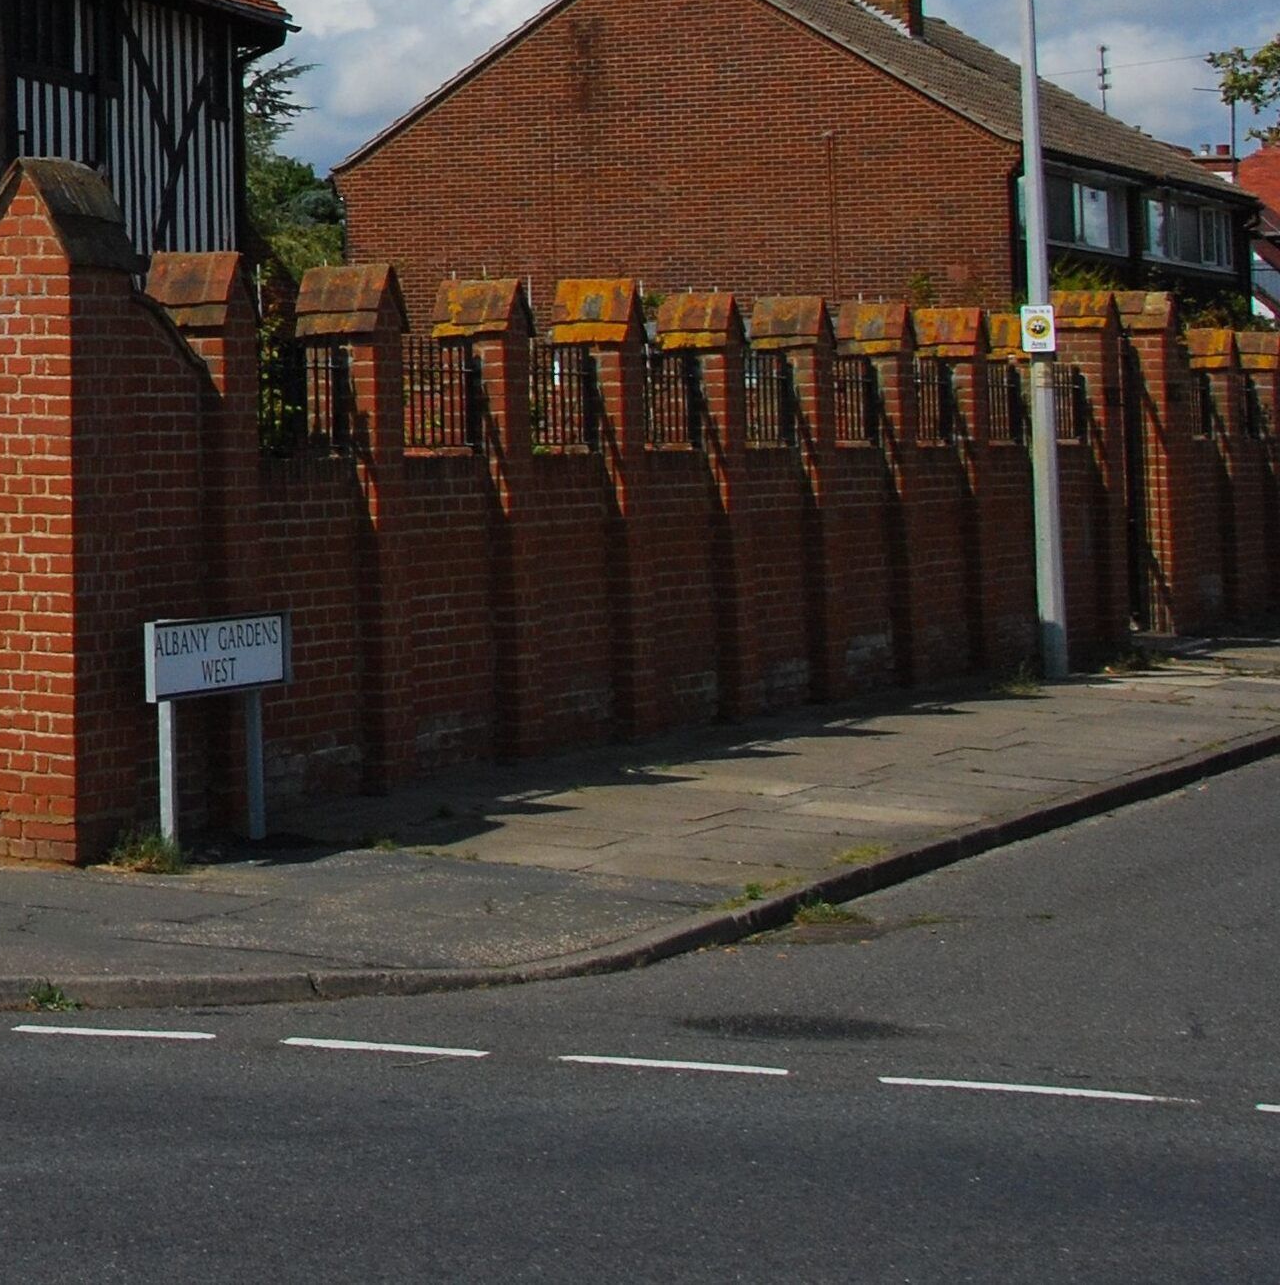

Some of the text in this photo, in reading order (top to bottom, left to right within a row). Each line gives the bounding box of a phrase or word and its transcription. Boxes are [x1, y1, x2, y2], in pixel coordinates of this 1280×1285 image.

[155, 620, 278, 657] ALBANY GARDENS
[202, 657, 237, 683] WEST
